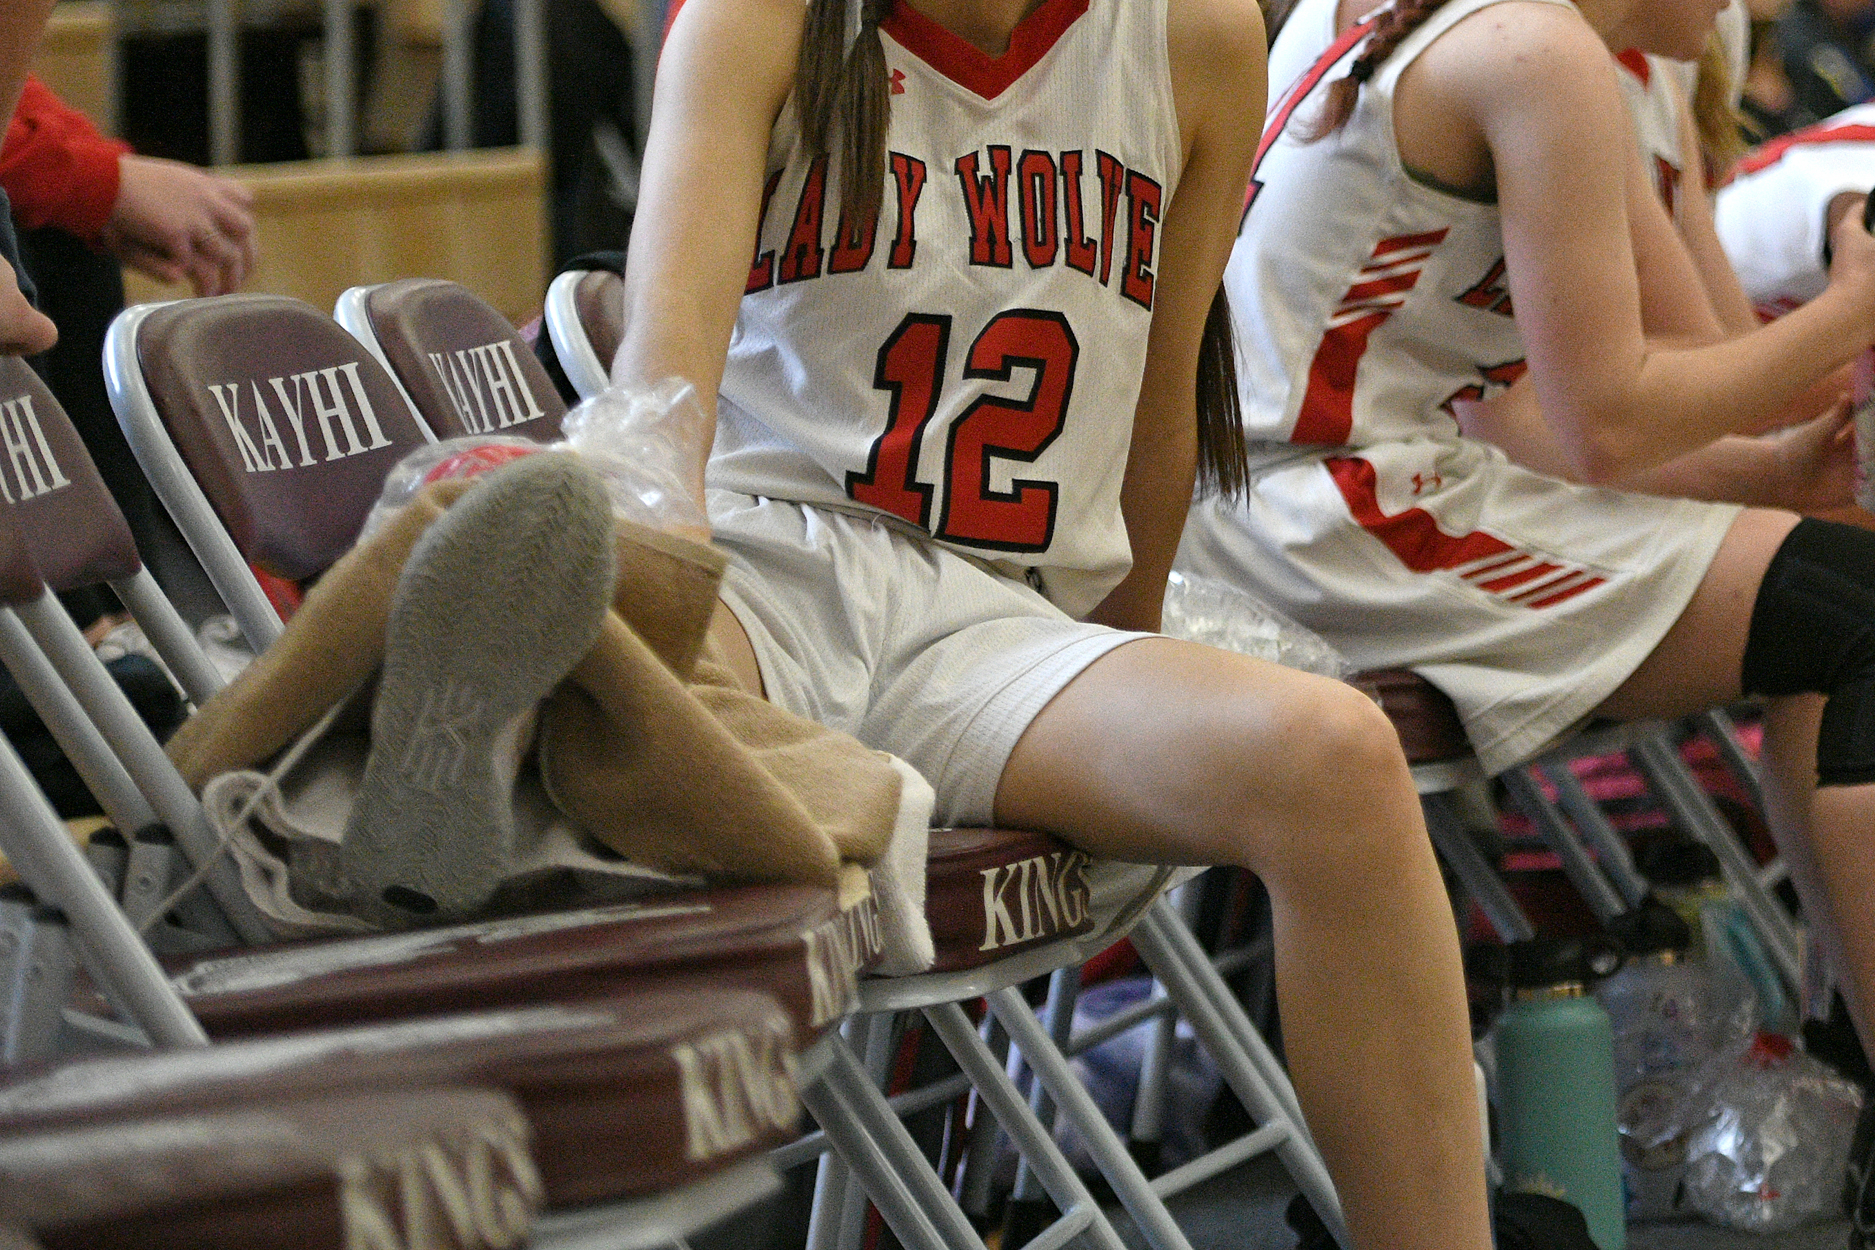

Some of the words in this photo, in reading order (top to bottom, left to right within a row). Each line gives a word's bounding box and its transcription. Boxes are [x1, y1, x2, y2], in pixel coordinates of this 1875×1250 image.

[208, 362, 393, 473] KAYHI
[428, 340, 545, 436] KAYHI
[845, 308, 1079, 553] 12
[0, 395, 72, 504] HI
